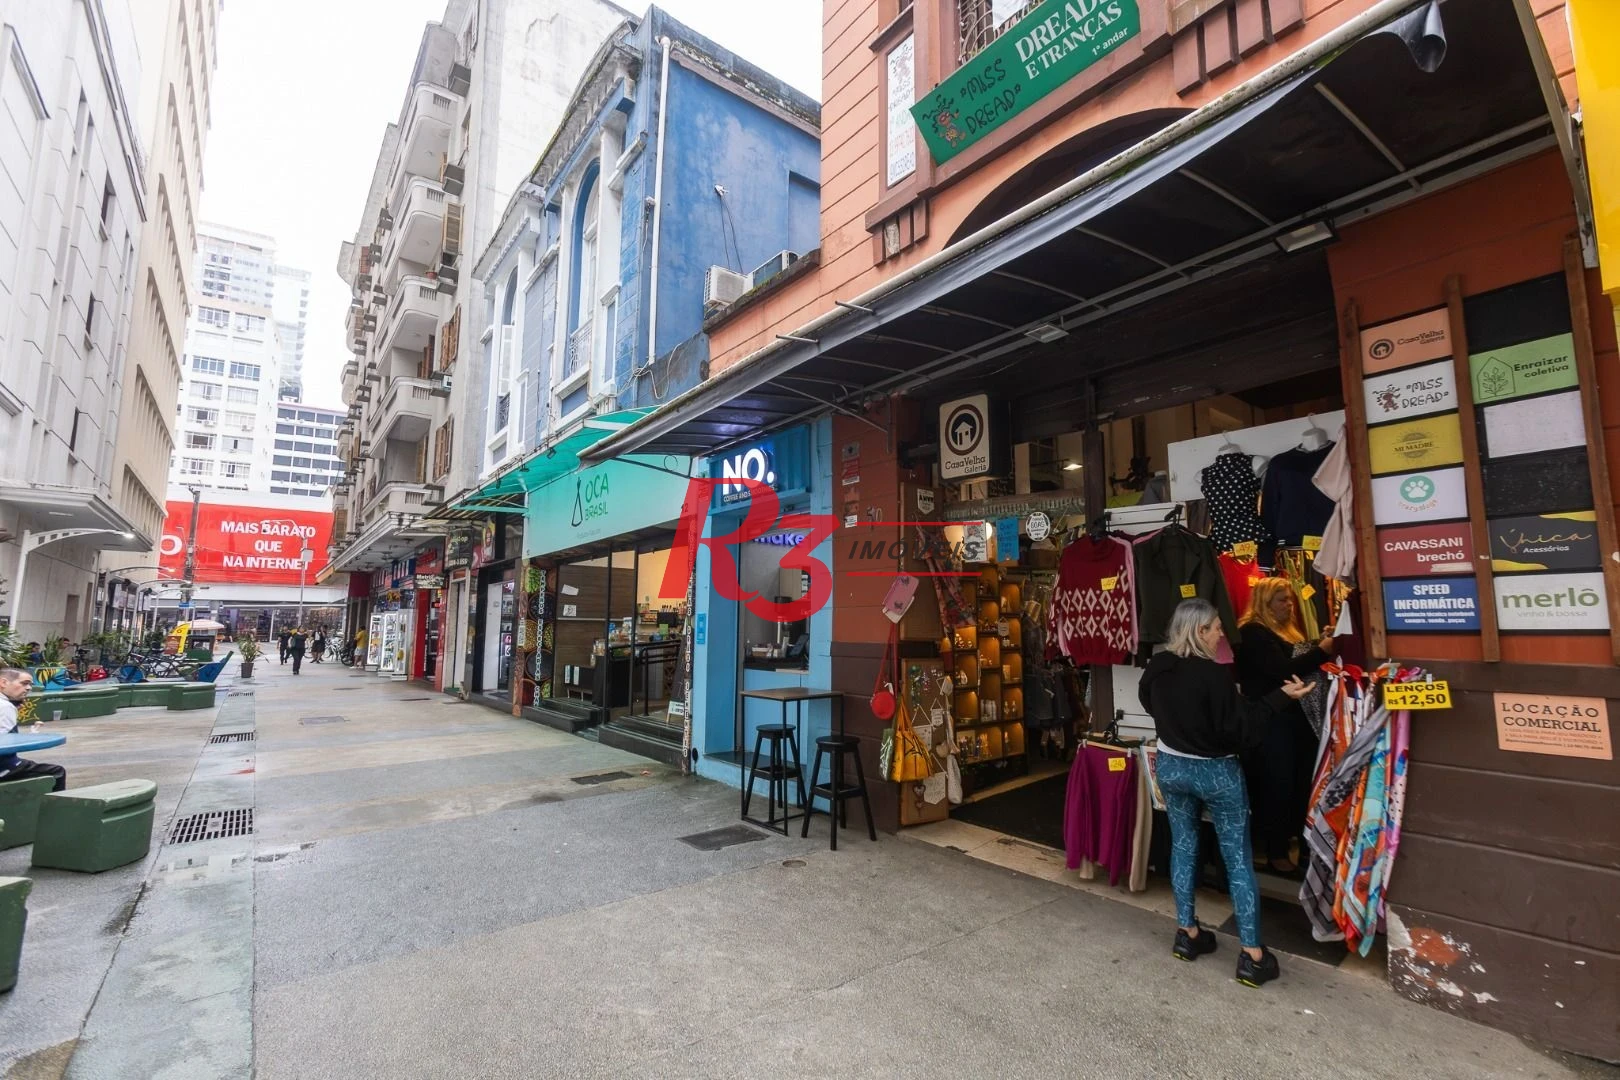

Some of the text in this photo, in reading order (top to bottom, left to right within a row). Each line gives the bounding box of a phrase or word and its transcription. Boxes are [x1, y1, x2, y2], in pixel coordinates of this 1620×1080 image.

[1015, 0, 1108, 62] DREAD
[1025, 1, 1122, 80] E TRANÇAS
[1102, 27, 1129, 50] andar
[1514, 355, 1569, 371] Enraizar
[1524, 364, 1569, 378] coletiva
[585, 472, 609, 503] OCA
[585, 502, 609, 521] BRASIL
[221, 521, 258, 534] MAIS
[261, 522, 316, 538] BARATO
[254, 540, 283, 553] QUE
[1384, 537, 1463, 551] CAVASSANI
[1523, 545, 1570, 553] Acessórios
[223, 555, 245, 568] NA
[1416, 550, 1465, 562] brechó
[1412, 584, 1450, 595] SPEED
[1393, 597, 1475, 610] INFORMÁTICA
[1502, 587, 1600, 608] merlô
[1387, 683, 1445, 692] LENÇOS
[1501, 703, 1599, 718] LOCAÇÃO
[1503, 716, 1601, 732] COMERCIAL
